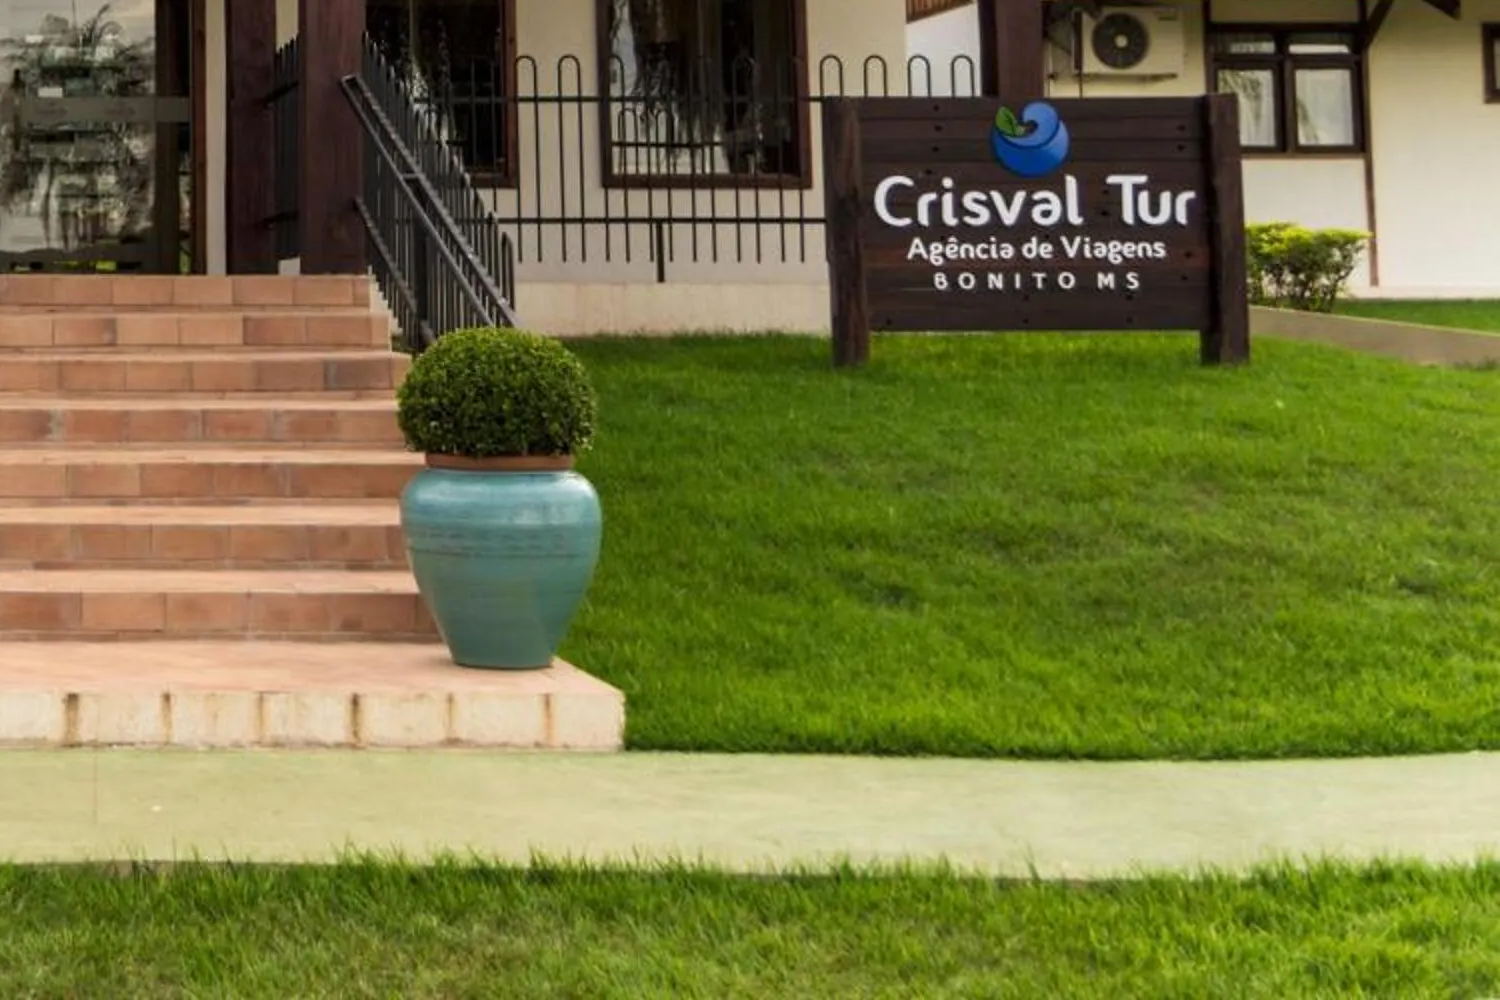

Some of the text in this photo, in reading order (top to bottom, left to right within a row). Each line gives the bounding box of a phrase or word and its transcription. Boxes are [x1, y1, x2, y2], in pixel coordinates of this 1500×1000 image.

[874, 174, 1196, 227] Crisval Tur
[907, 236, 1167, 266] Agência de Viagens
[934, 272, 1140, 290] BONITO MS
